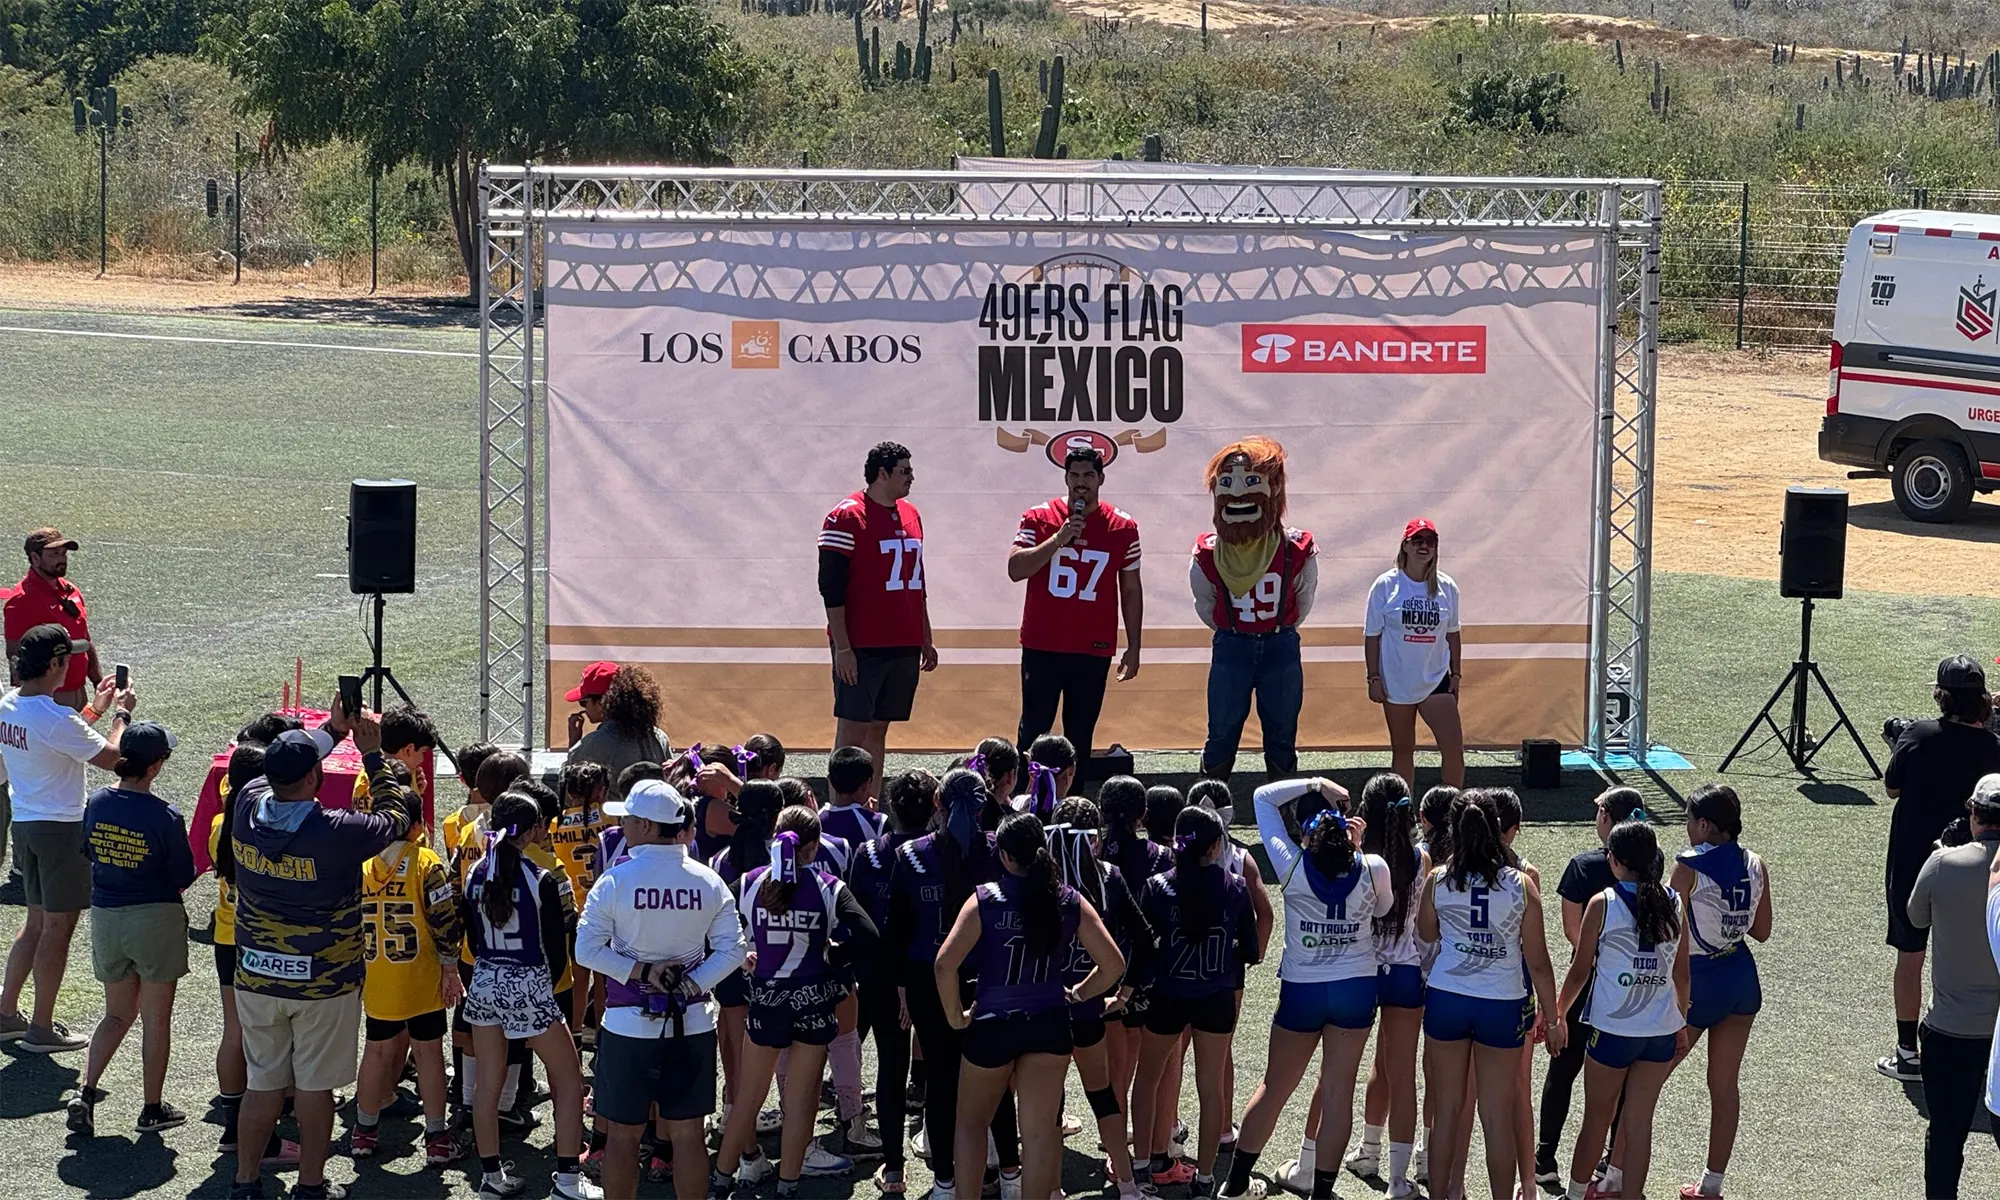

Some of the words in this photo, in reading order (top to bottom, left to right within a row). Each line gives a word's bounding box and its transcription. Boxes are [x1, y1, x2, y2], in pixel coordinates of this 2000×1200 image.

[1870, 282, 1896, 299] 10
[978, 283, 1090, 341] 49ERS
[1103, 284, 1184, 342] FLAG
[639, 332, 724, 364] LOS
[787, 333, 922, 364] CABOS
[1304, 341, 1478, 362] BANORTE
[978, 333, 1184, 423] MÉXICO
[879, 538, 922, 591] 77
[1048, 546, 1110, 601] 67
[1231, 572, 1282, 622] 49
[0, 722, 28, 751] OACH
[232, 836, 318, 881] COACH
[634, 888, 702, 910] COACH
[1470, 887, 1489, 929] 5
[756, 907, 821, 930] PEREZ
[1300, 920, 1360, 934] BATTAGLIA
[1467, 932, 1493, 944] TATA
[259, 957, 308, 974] ARES
[766, 930, 810, 979] 7
[1632, 957, 1658, 970] NICO
[1633, 975, 1667, 986] ARES
